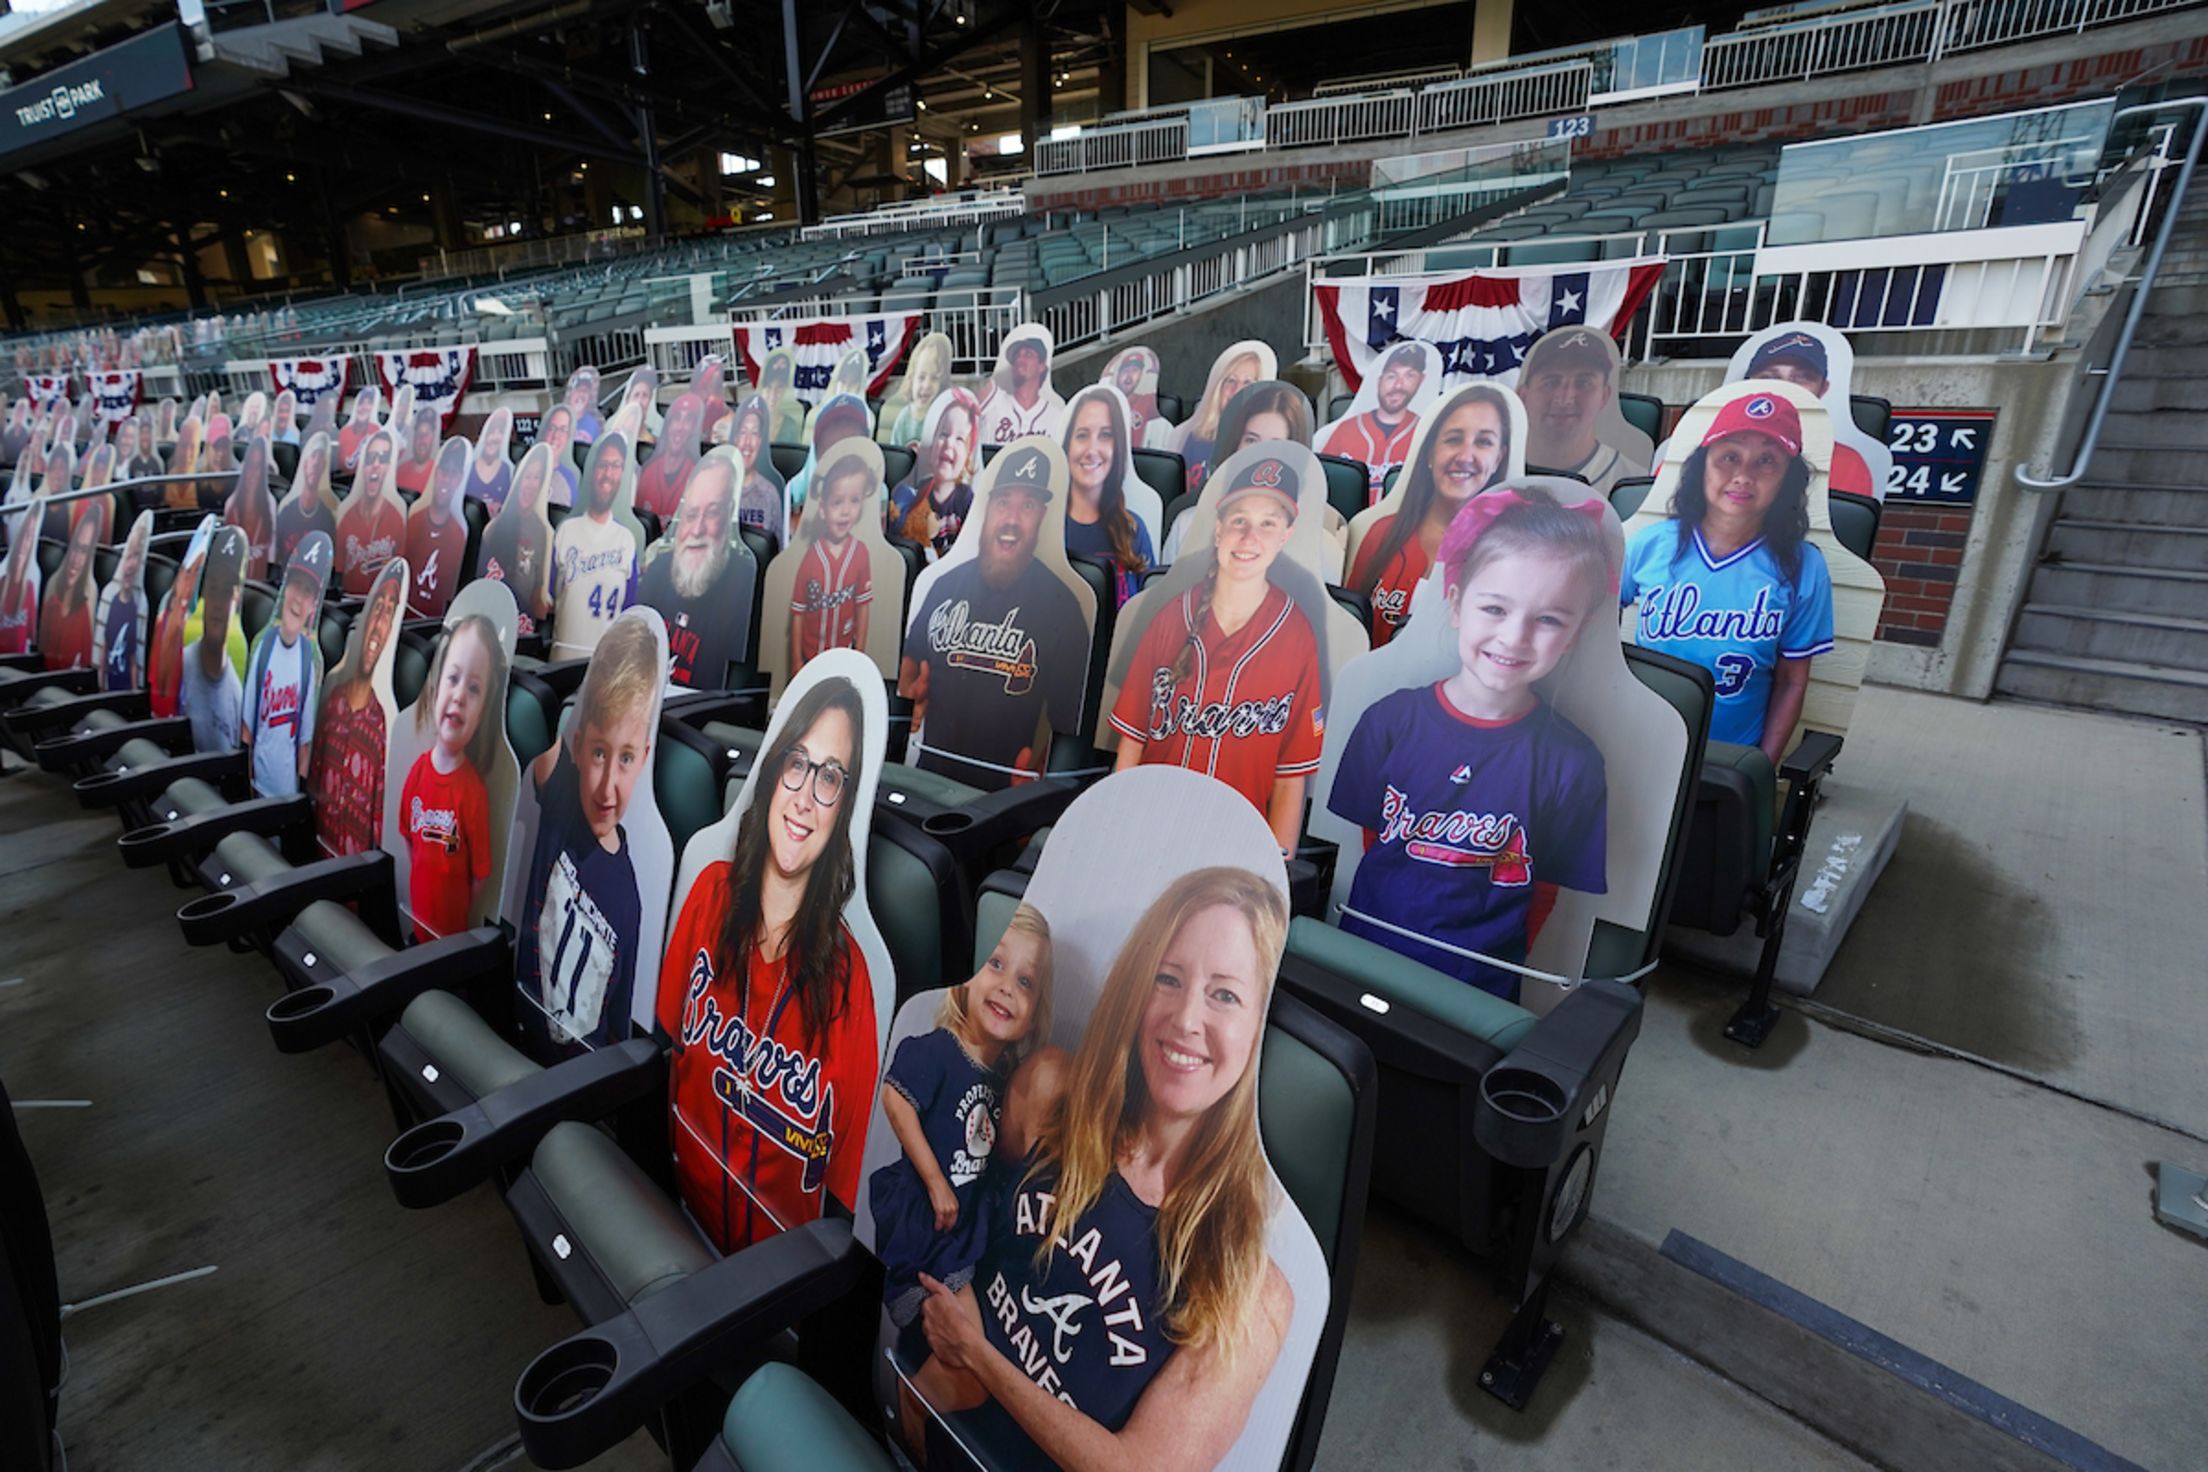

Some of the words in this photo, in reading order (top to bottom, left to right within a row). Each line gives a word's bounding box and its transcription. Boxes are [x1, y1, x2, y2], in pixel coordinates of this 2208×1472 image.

[16, 97, 56, 127] TRUIST
[69, 79, 104, 107] PARK
[1556, 117, 1590, 137] 123
[1015, 456, 1038, 479] A
[416, 548, 440, 590] A
[564, 545, 626, 585] Braves
[587, 584, 620, 620] 44
[929, 599, 1024, 657] Atlanta
[1639, 580, 1784, 642] Atlanta
[1714, 652, 1757, 698] 3
[1150, 667, 1295, 741] Braves
[1380, 784, 1514, 849] Braves
[682, 947, 820, 1118] Braves
[1016, 1191, 1148, 1367] ATANTA
[1020, 1283, 1094, 1364] A
